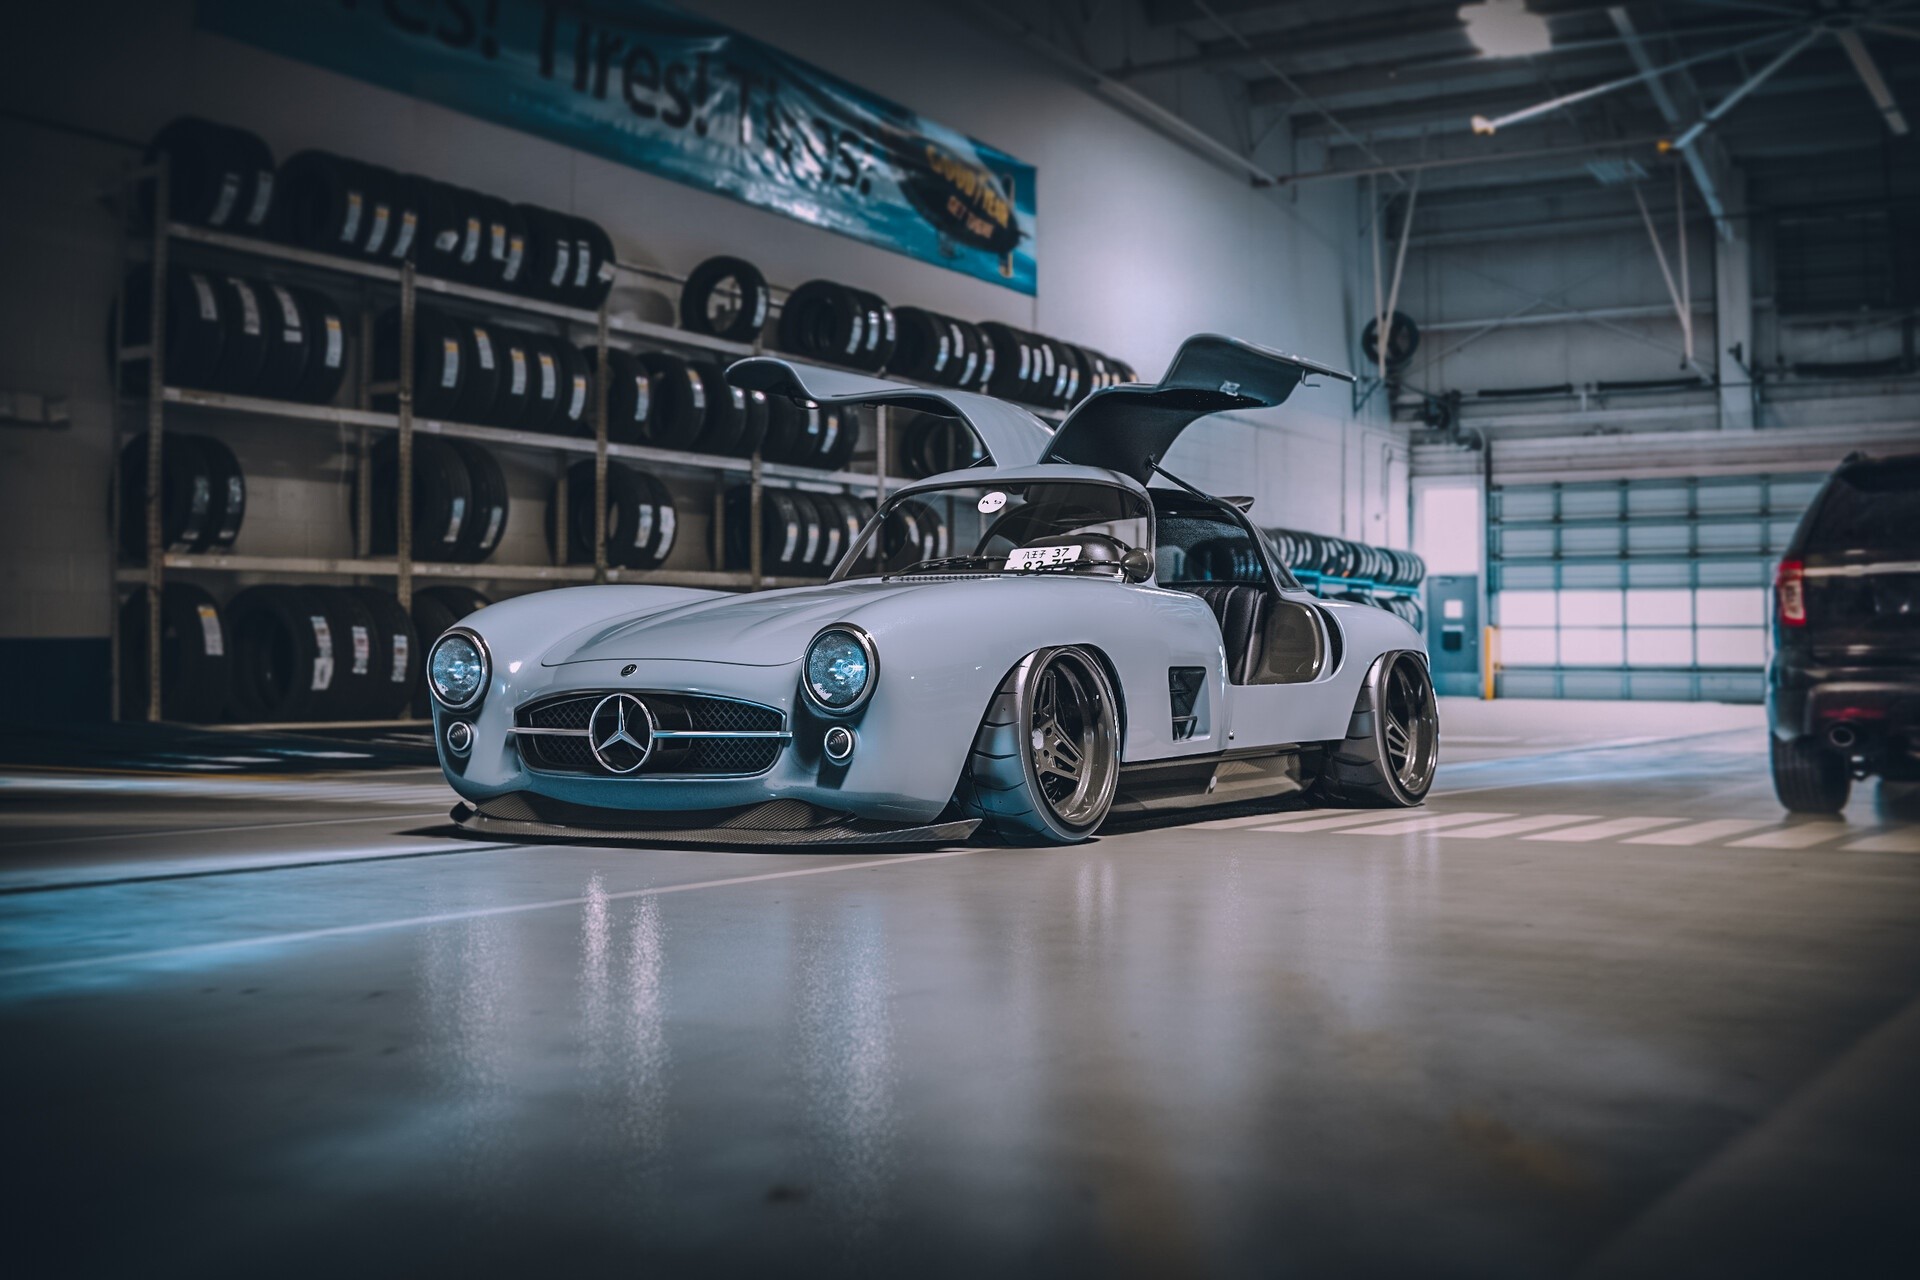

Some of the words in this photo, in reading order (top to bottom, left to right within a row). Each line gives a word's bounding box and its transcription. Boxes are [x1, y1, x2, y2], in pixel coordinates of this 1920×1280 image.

[538, 0, 708, 137] Tires!
[1022, 550, 1046, 559] 八王子
[1052, 548, 1070, 557] 37
